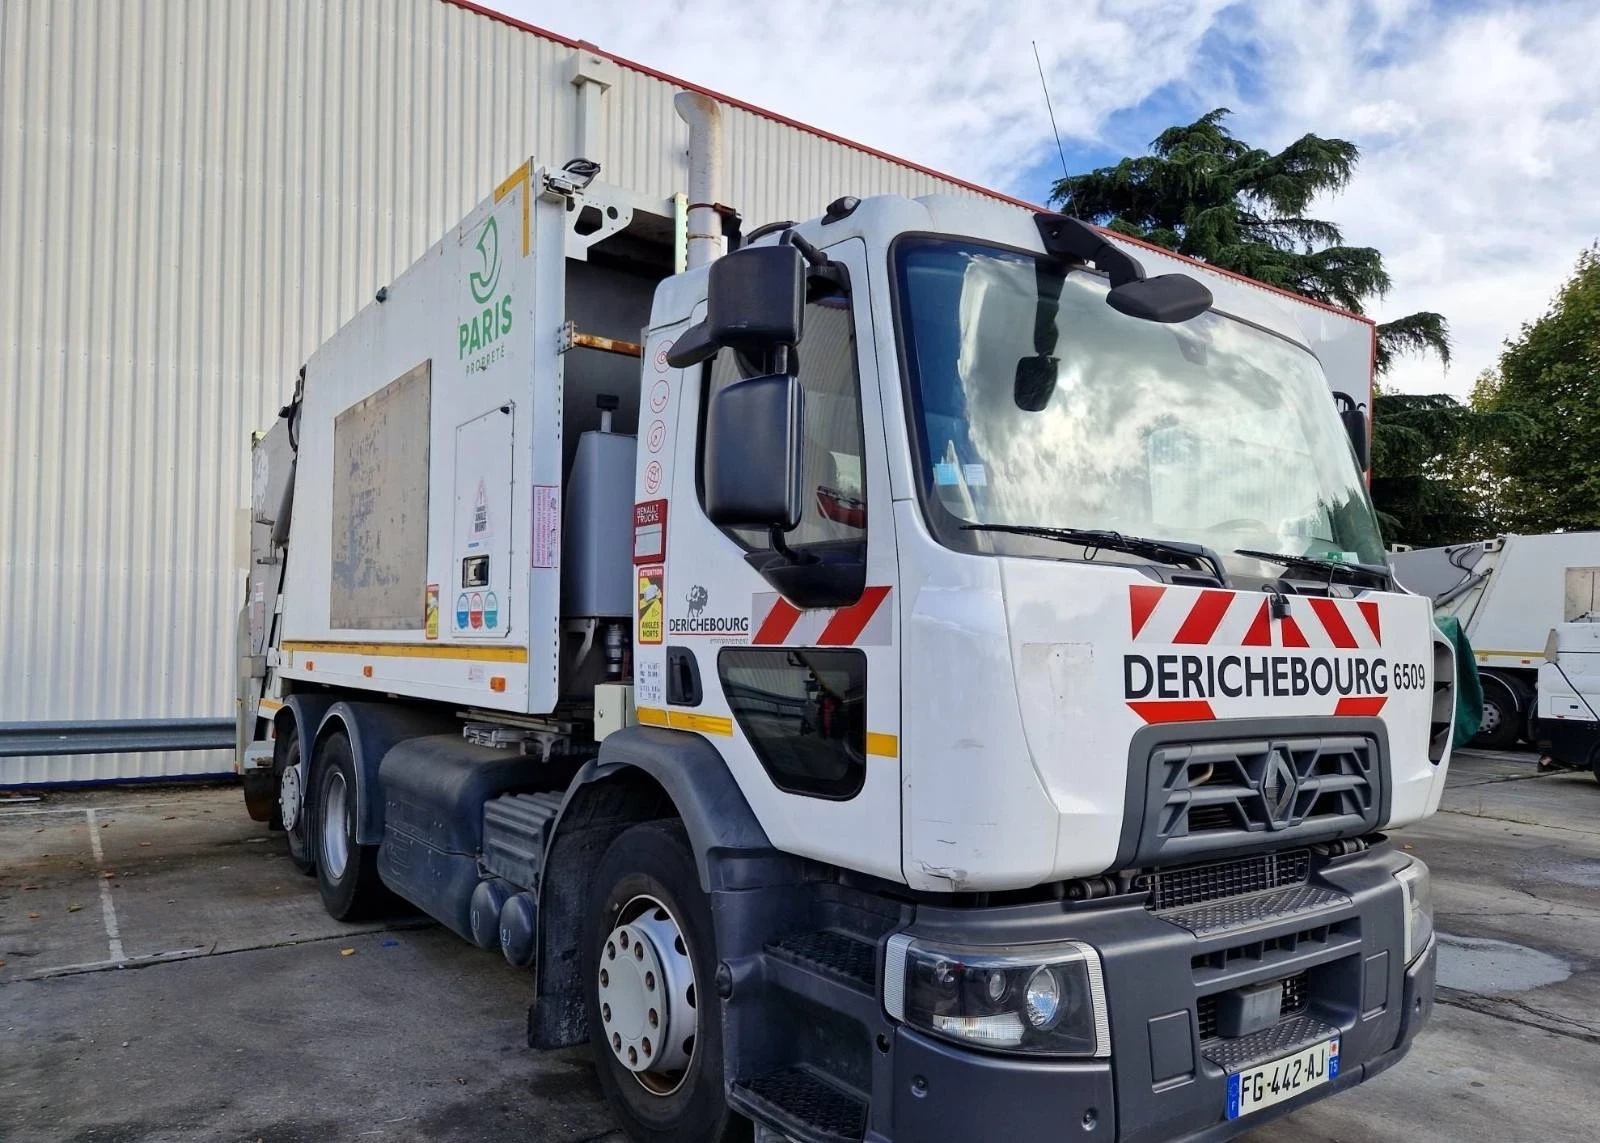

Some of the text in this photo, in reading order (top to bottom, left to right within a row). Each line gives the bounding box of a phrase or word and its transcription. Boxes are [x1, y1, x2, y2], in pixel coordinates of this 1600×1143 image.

[459, 294, 513, 361] PARIS
[637, 504, 659, 516] RENAULT
[637, 513, 659, 525] TRUCKS
[642, 621, 659, 629] ANGLES
[669, 617, 749, 632] DERICHEBOURG
[642, 630, 659, 638] MORTS
[1124, 654, 1426, 700] DERICHEBOURG 6509
[1330, 1060, 1338, 1073] 75
[1241, 1048, 1325, 1106] FG-442-AJ
